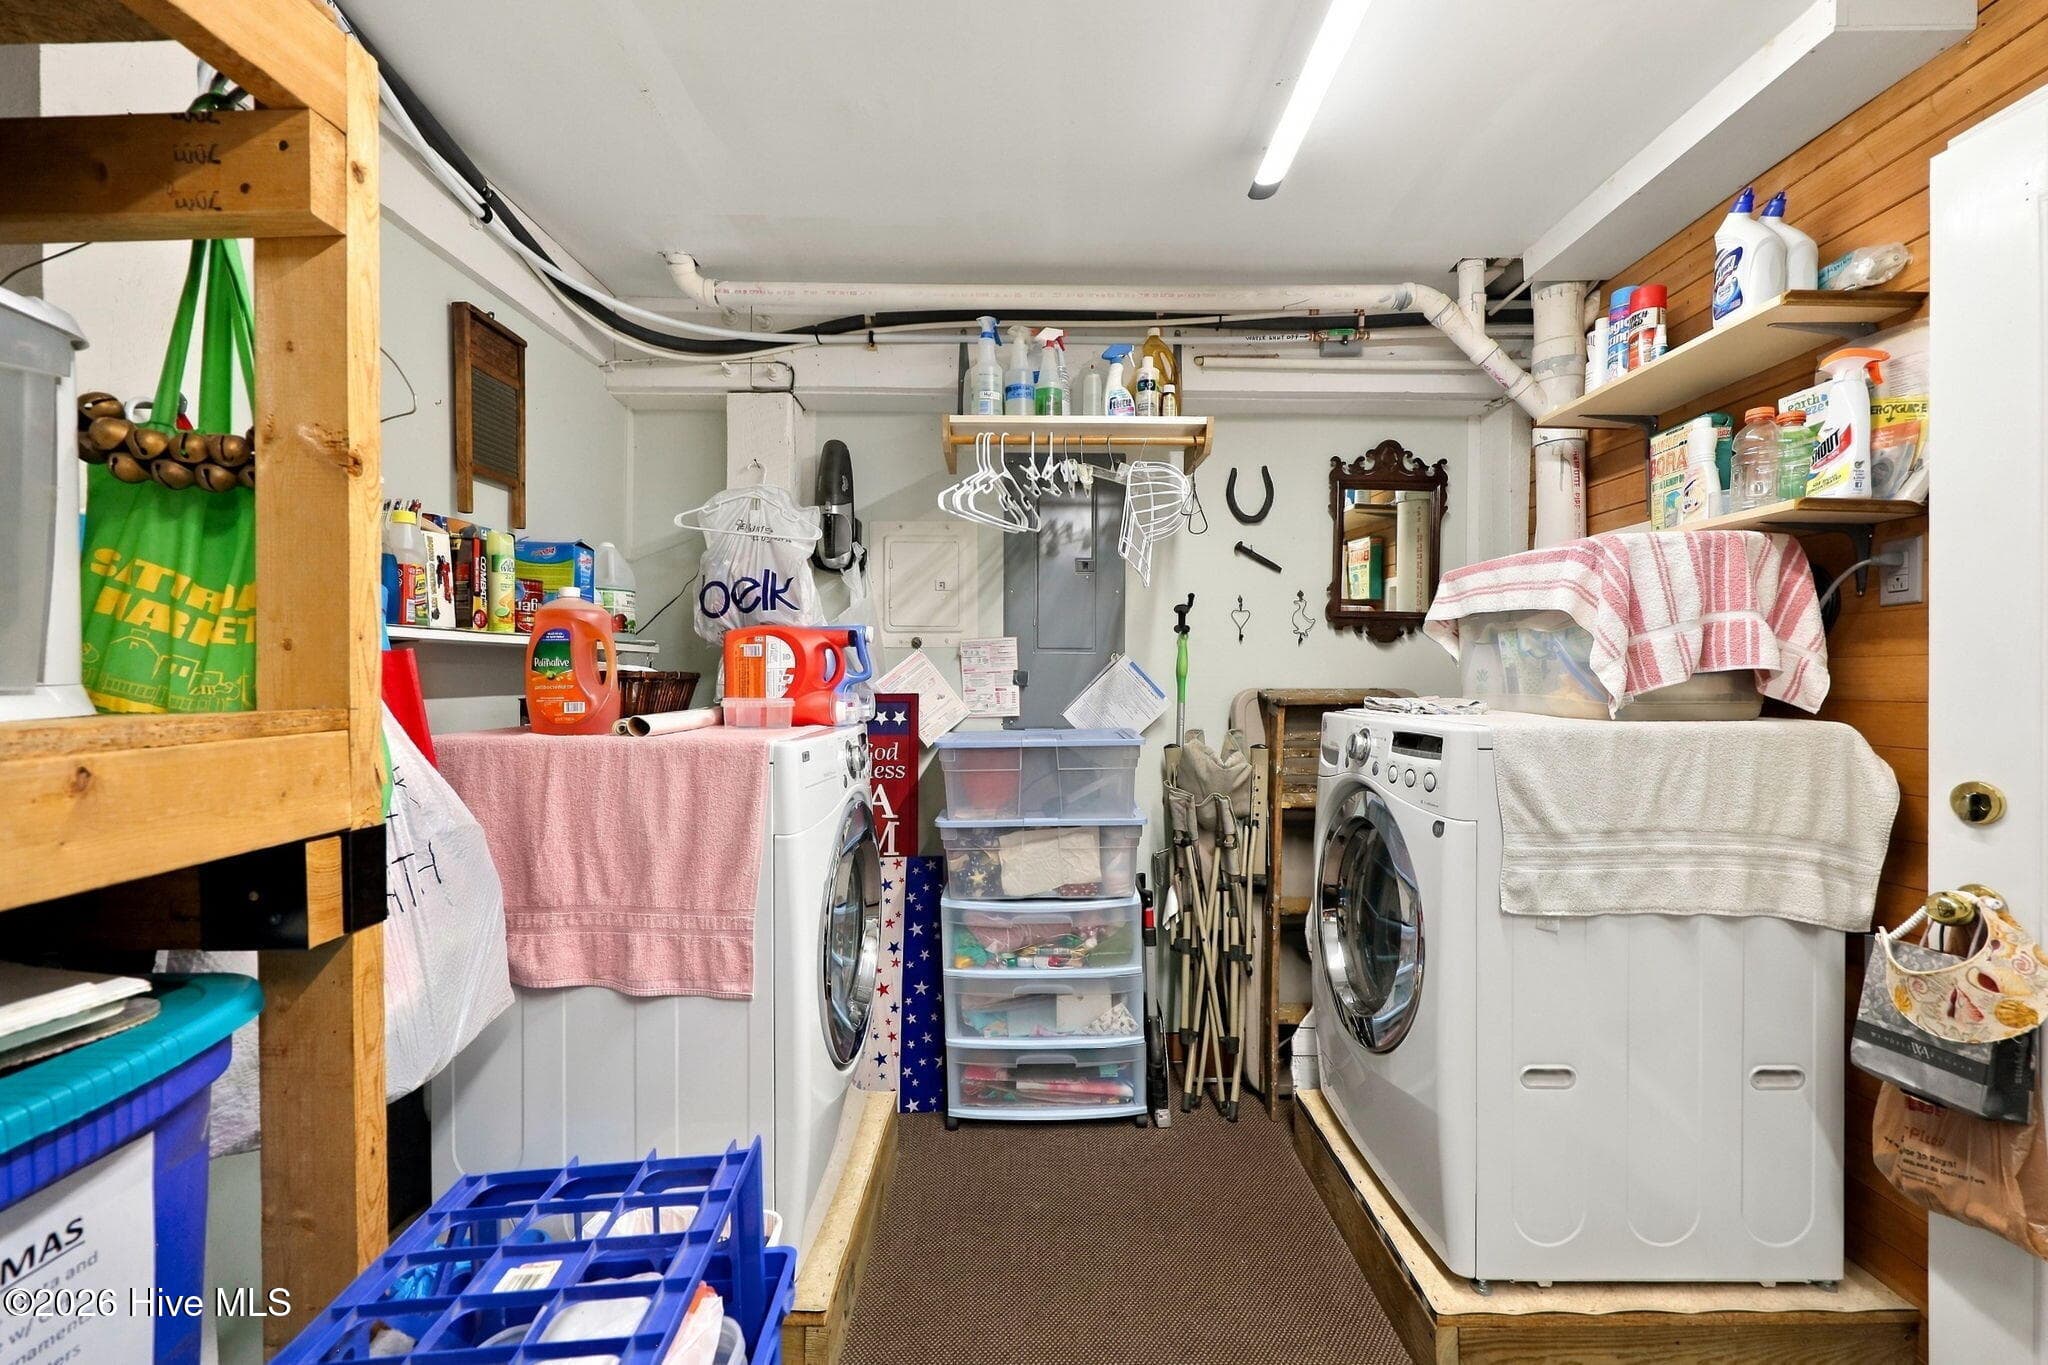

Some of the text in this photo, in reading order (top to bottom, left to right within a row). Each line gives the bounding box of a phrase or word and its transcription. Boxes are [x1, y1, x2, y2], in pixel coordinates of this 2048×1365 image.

[1788, 394, 1820, 412] earth
[1805, 402, 1824, 415] eze
[1650, 446, 1688, 482] BORA
[480, 556, 488, 600] COMBAT
[699, 569, 801, 619] belk
[534, 656, 570, 667] Palmolive
[871, 764, 906, 779] ess
[65, 1250, 98, 1281] and
